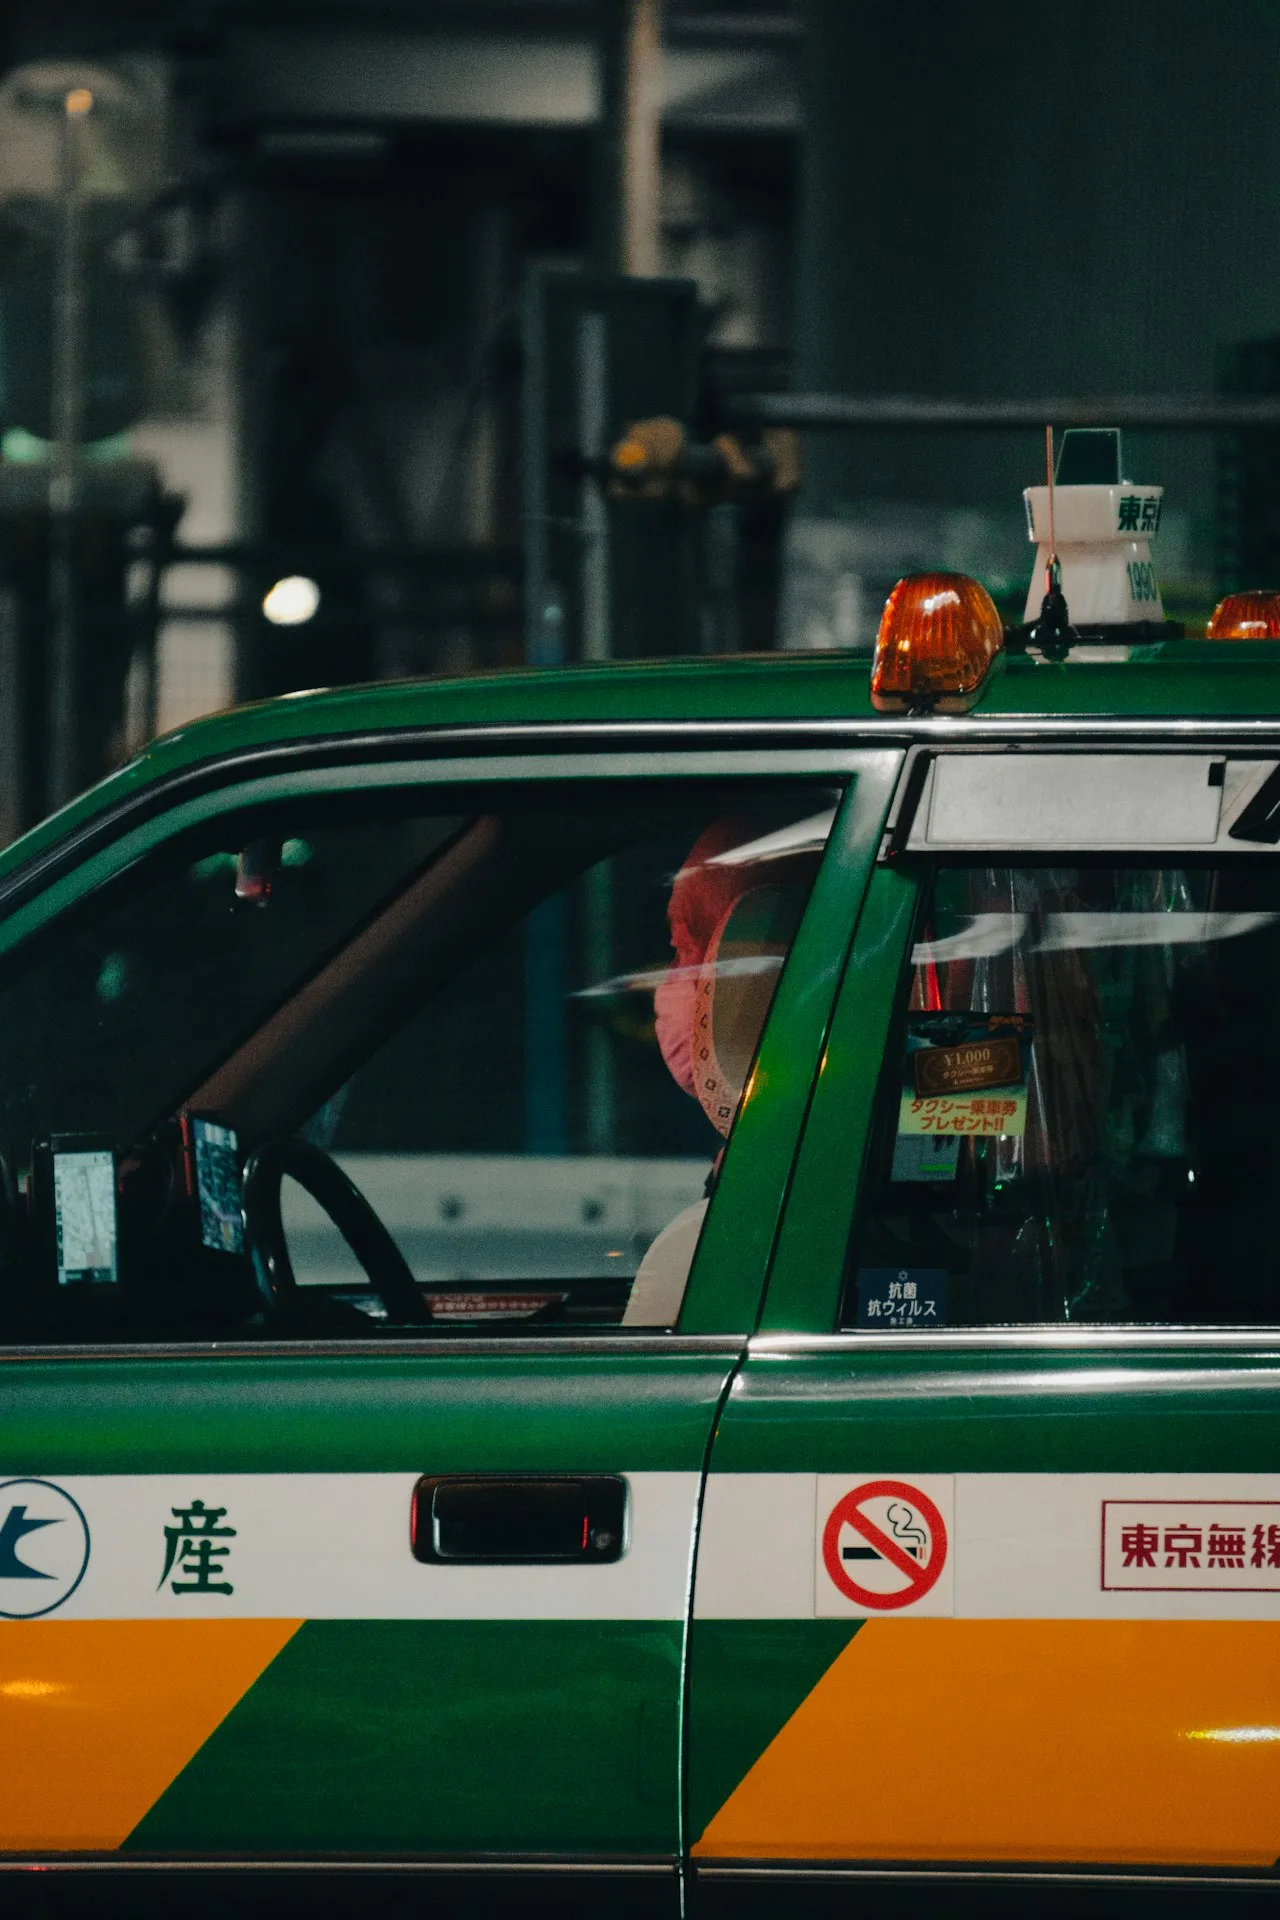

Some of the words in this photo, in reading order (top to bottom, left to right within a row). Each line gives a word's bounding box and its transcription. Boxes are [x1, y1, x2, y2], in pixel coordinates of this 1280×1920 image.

[1118, 495, 1161, 532] 東京
[910, 1099, 1017, 1117] タクシー乗車券
[888, 1282, 917, 1299] 抗菌
[867, 1299, 936, 1317] 抗ウィルス
[156, 1499, 237, 1595] 産
[1121, 1524, 1280, 1568] 東京無線
